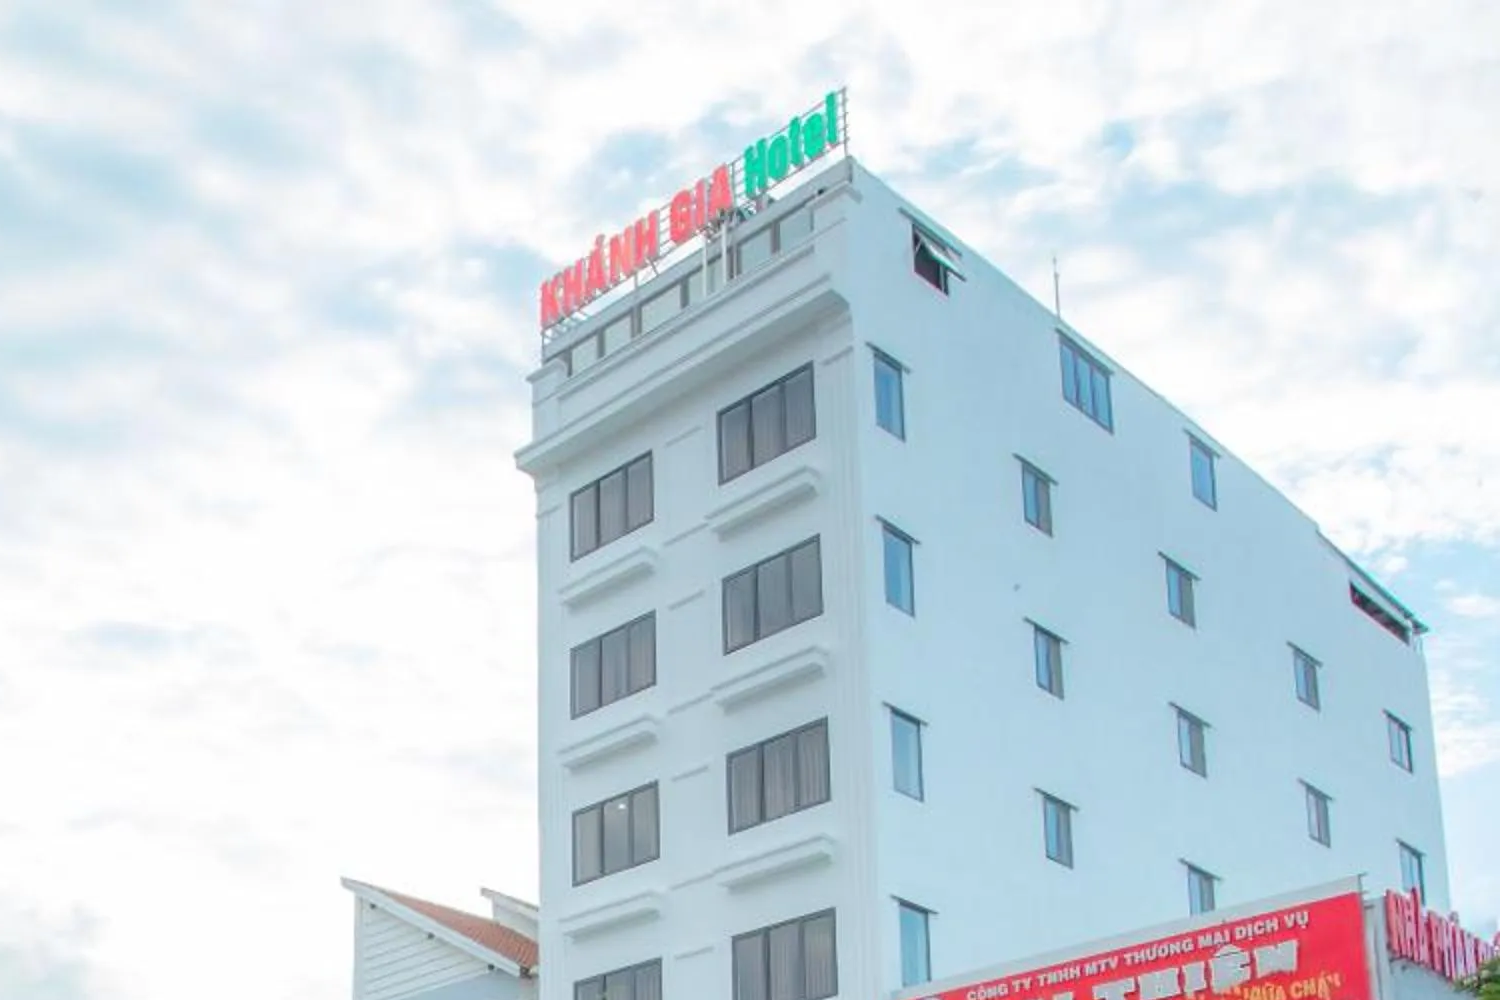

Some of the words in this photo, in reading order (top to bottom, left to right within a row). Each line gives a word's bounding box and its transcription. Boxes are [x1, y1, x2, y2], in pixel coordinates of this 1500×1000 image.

[540, 208, 658, 330] KHÁNH
[669, 163, 733, 247] GIA
[743, 91, 838, 198] Hotel
[1012, 976, 1033, 993] TY
[1037, 964, 1081, 987] TNHH
[1085, 955, 1119, 976] MTV
[1235, 916, 1279, 942] DỊCH
